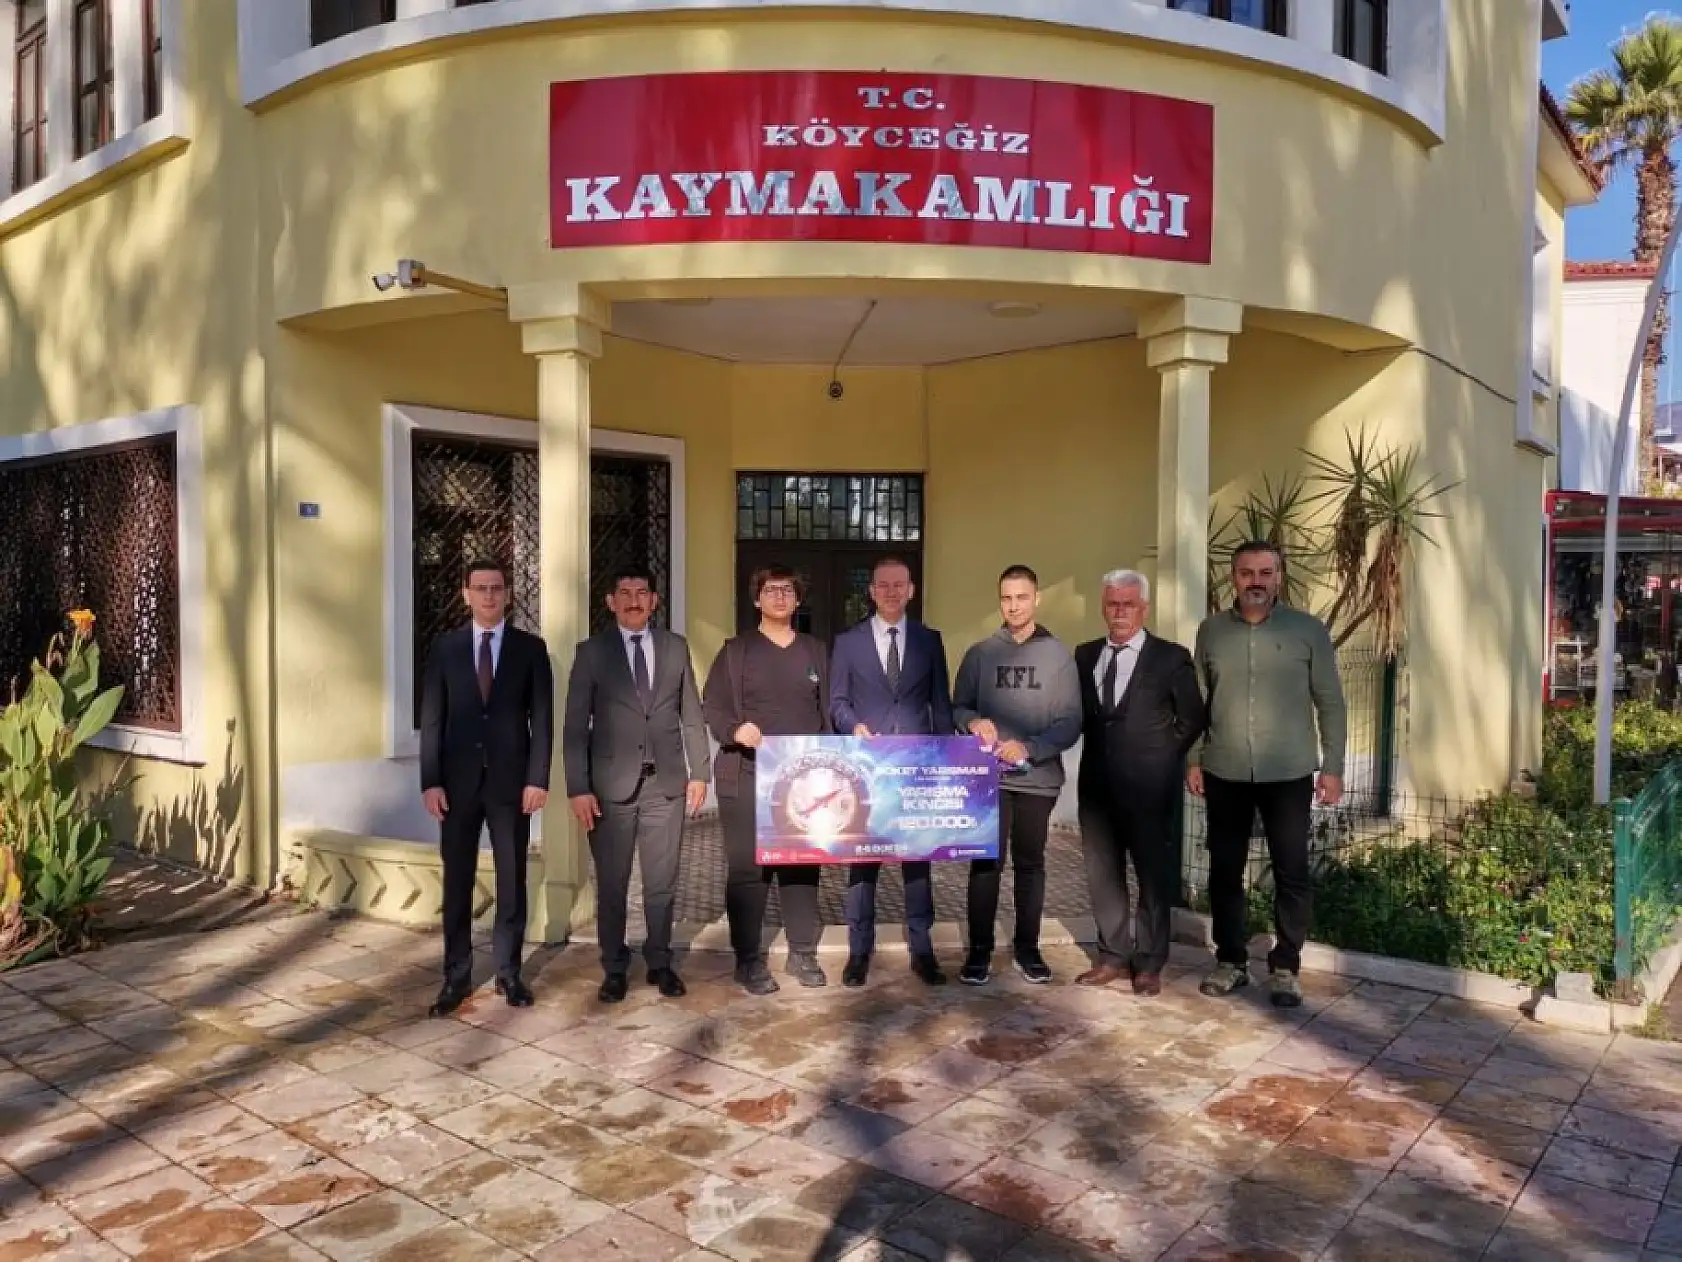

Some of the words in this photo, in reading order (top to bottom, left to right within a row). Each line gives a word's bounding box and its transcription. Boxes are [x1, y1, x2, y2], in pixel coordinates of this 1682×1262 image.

[858, 87, 945, 110] T.C.
[762, 117, 1030, 154] KÖYCEĞİZ
[565, 170, 1190, 238] KAYMAKAMLIĞI
[995, 665, 1042, 689] KFL
